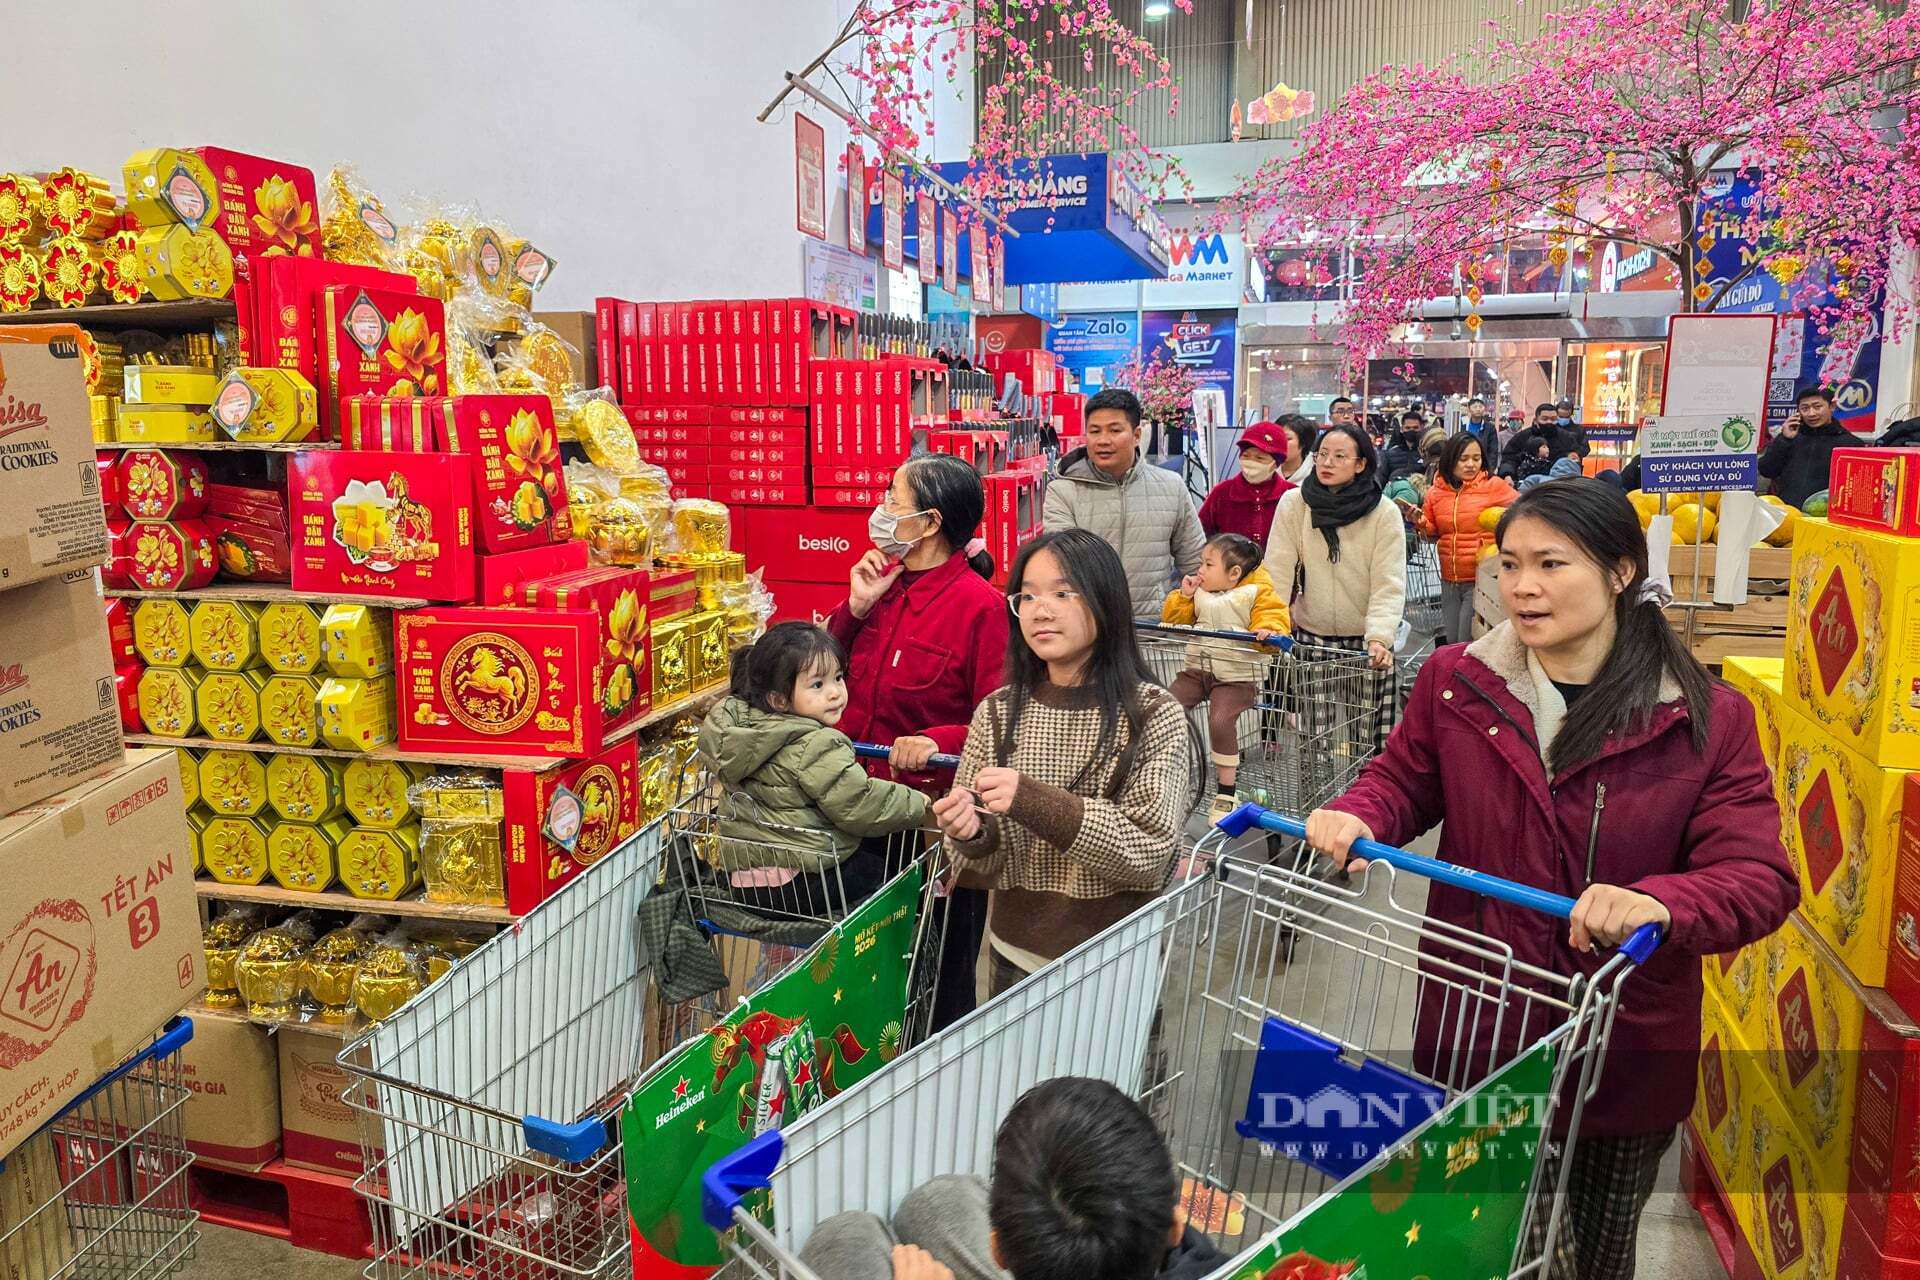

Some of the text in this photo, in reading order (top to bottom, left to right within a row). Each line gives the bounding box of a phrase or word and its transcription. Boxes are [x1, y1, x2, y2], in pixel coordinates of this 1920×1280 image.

[224, 199, 246, 213] BÁNH
[227, 223, 249, 237] XANH
[1086, 317, 1127, 334] Zalo
[1178, 326, 1207, 335] CLICK
[54, 343, 76, 354] TIN
[1183, 340, 1210, 352] GET
[481, 443, 501, 456] BÁNH
[1650, 441, 1672, 449] XANH
[1677, 440, 1698, 449] SẠCH
[1, 451, 59, 471] COOKIES
[1650, 460, 1750, 471] QUÝ KHÁCH VUI LÒNG
[485, 469, 505, 480] XANH
[1675, 474, 1700, 484] DỤNG
[303, 513, 324, 525] BÁNH
[304, 537, 325, 546] XANH
[799, 534, 850, 553] besico
[67, 568, 89, 580] BOX
[413, 666, 433, 676] BÁNH
[414, 685, 434, 693] XANH
[101, 853, 174, 918] TẾT AN
[134, 902, 155, 943] 3
[854, 934, 876, 957] 2026
[181, 959, 192, 981] 4
[15, 1076, 50, 1108] CÁCH:
[25, 1105, 38, 1120] kg
[57, 1067, 79, 1093] HỘP
[205, 1082, 227, 1096] GIA
[655, 1090, 705, 1130] Heineken
[757, 1084, 773, 1127] SILVER
